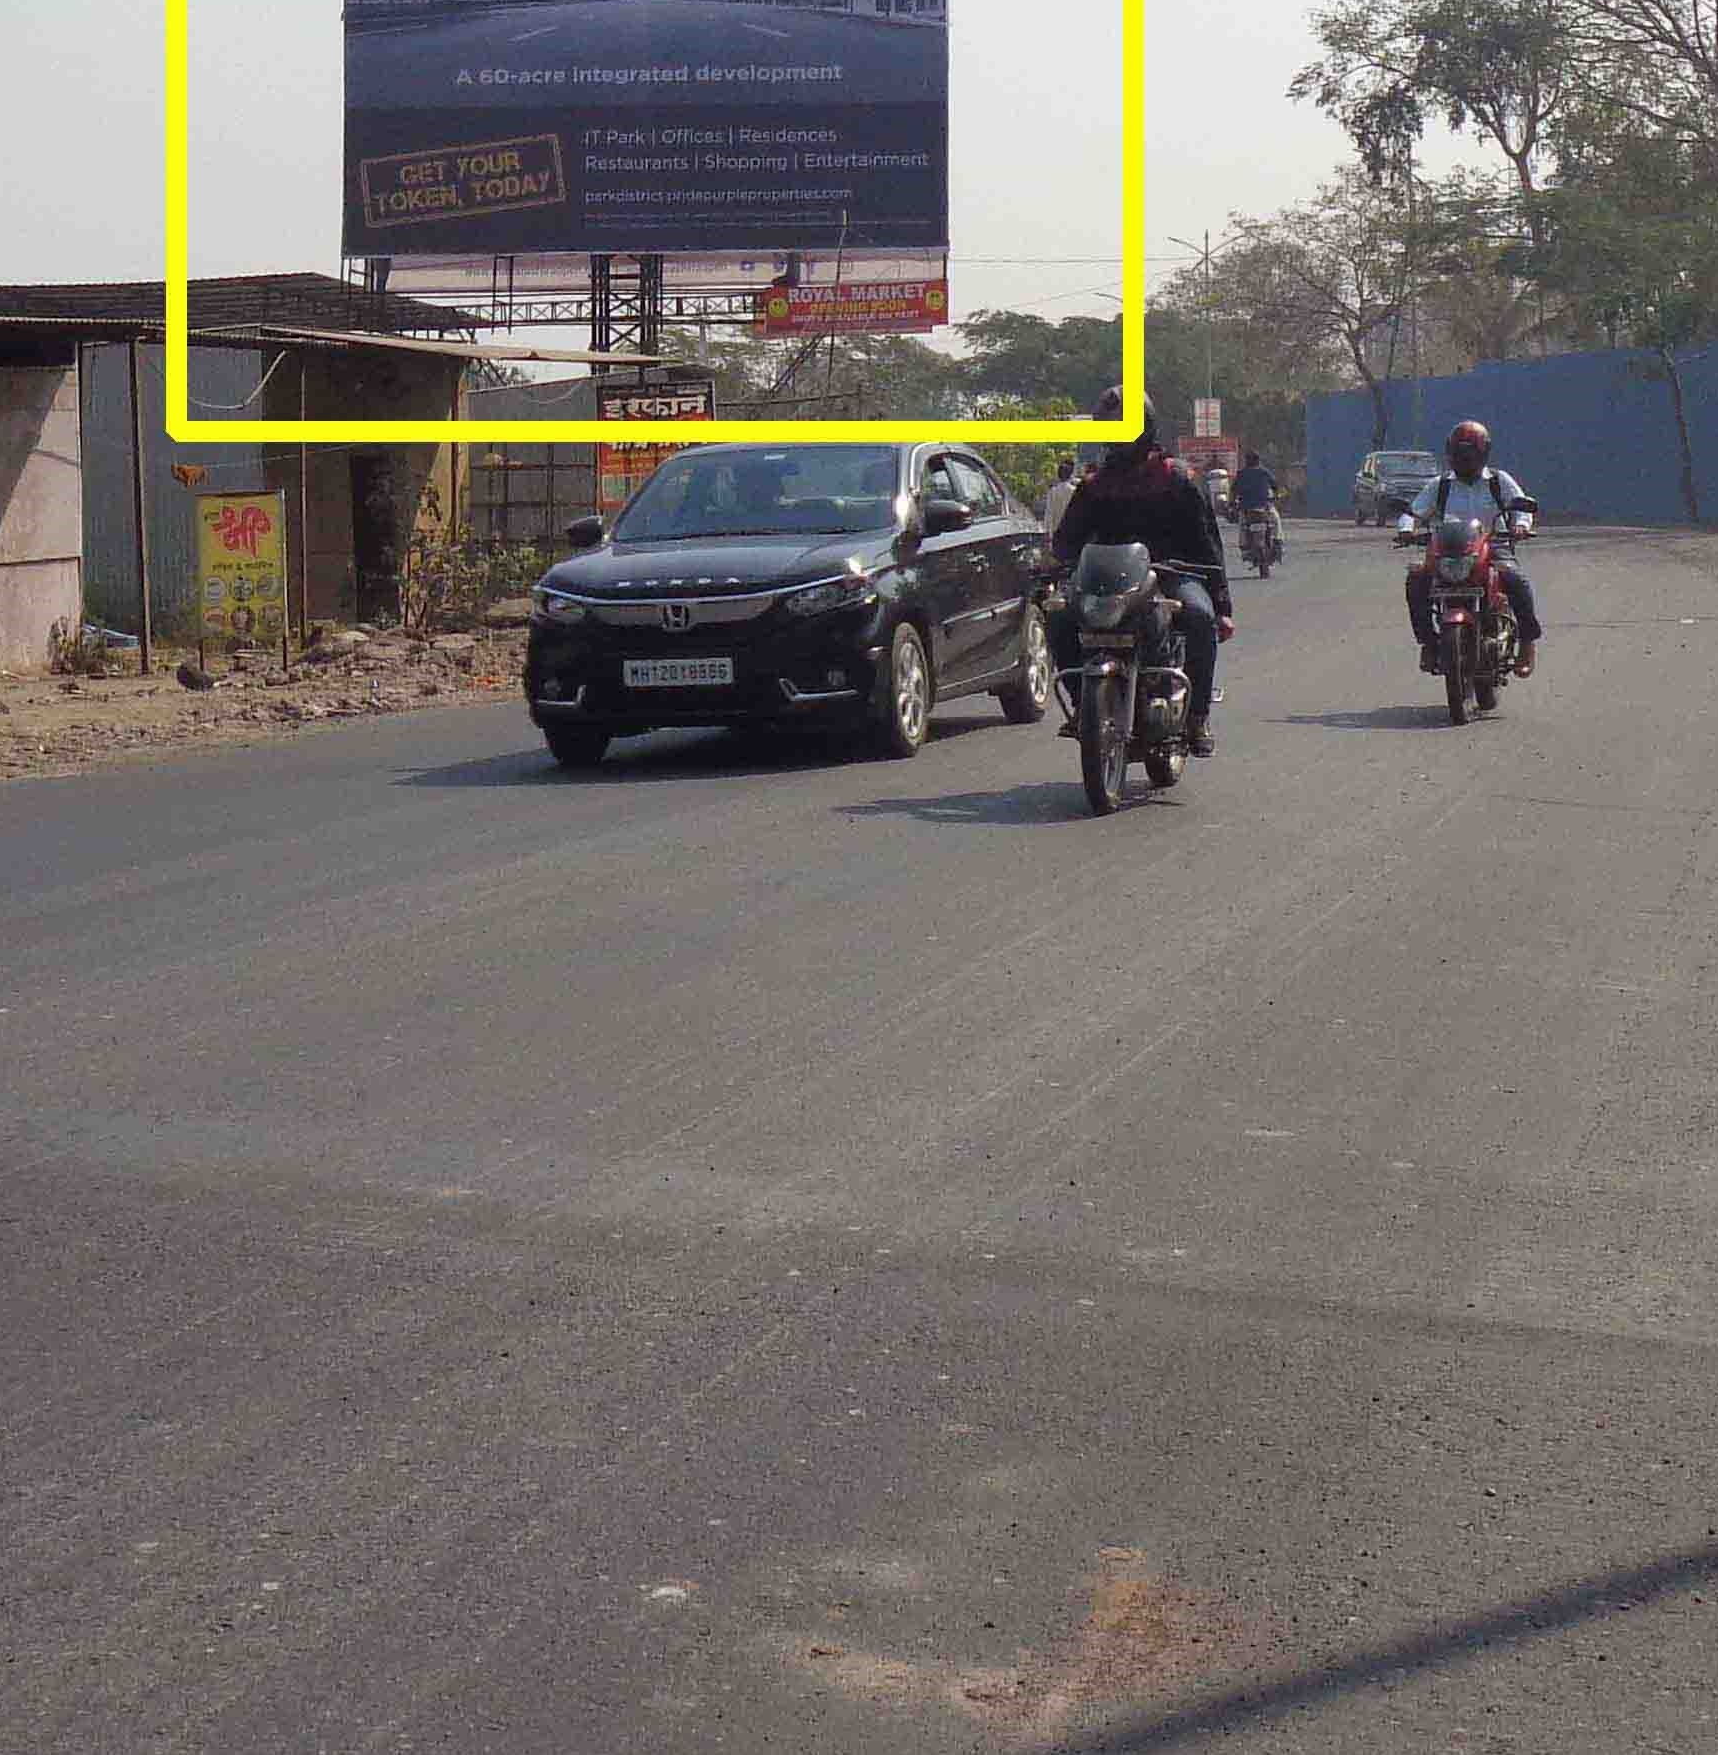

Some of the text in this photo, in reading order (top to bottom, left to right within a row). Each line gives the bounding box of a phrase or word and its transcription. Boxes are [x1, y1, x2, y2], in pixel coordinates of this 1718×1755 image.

[457, 71, 473, 84] A
[695, 64, 843, 83] development
[607, 131, 644, 144] Park
[661, 129, 723, 143] Offices
[739, 128, 837, 143] Residences
[400, 149, 522, 182] GET YOUR
[585, 155, 689, 171] Restaurants
[704, 155, 788, 173] Shopping
[804, 152, 930, 168] Entertainment
[473, 169, 550, 201] TODAY
[788, 283, 924, 303] ROYAL MARKET
